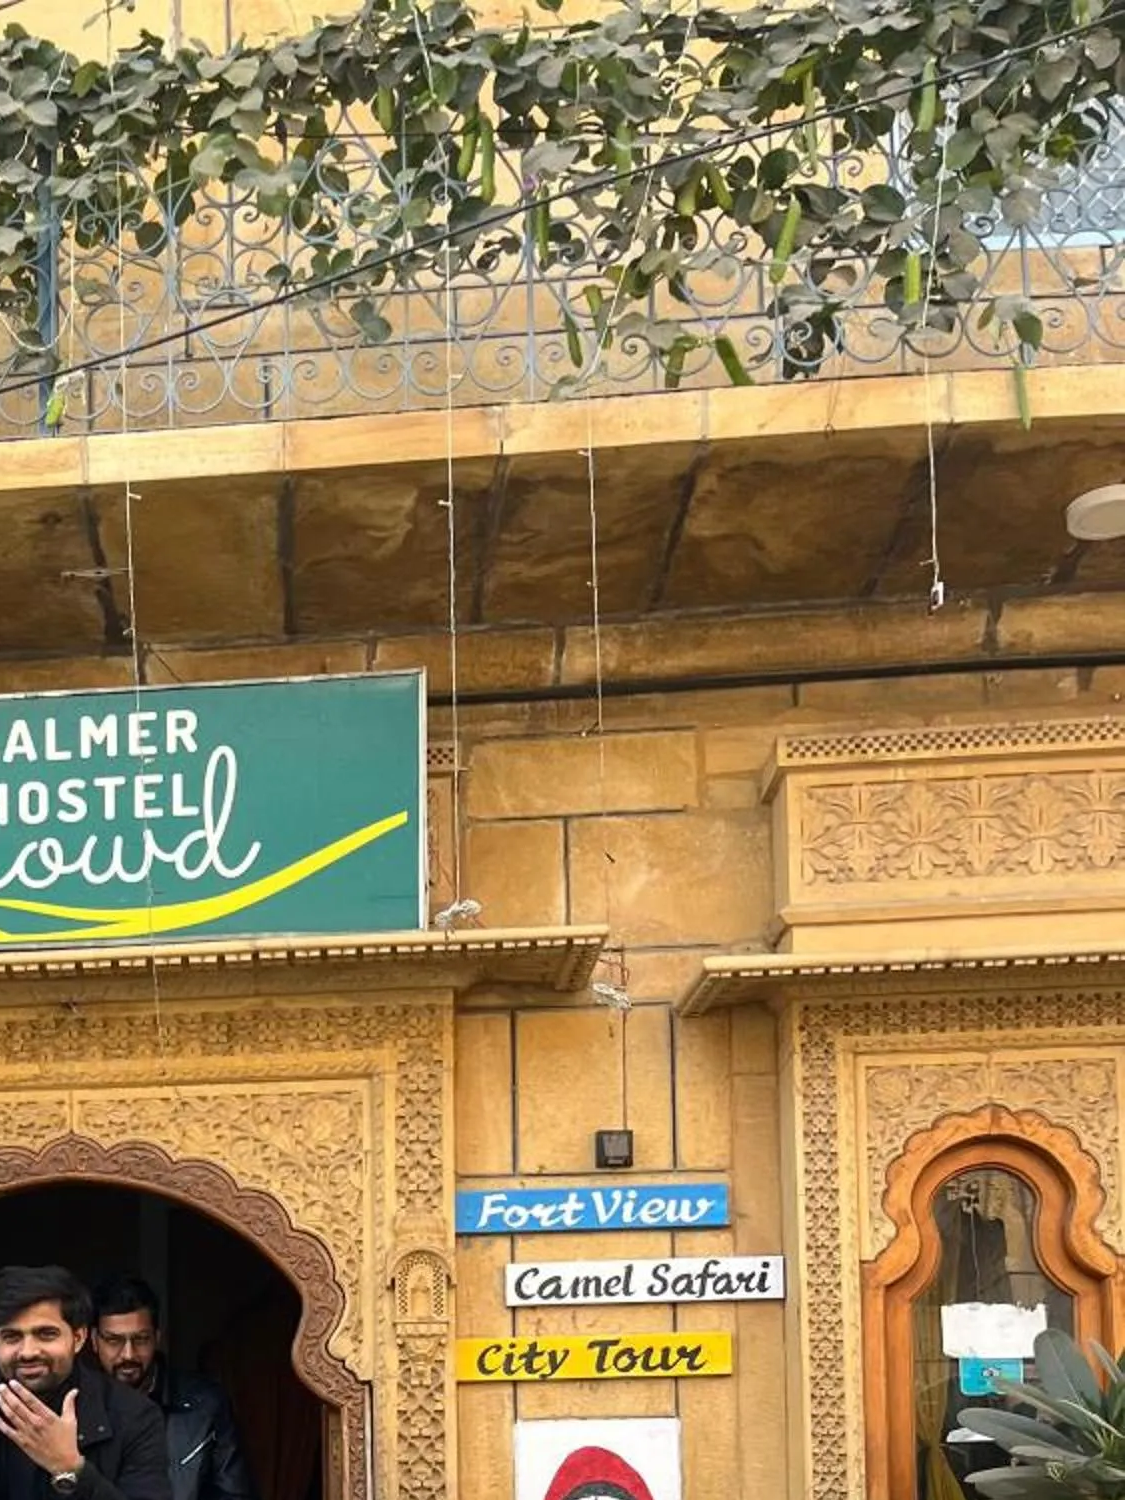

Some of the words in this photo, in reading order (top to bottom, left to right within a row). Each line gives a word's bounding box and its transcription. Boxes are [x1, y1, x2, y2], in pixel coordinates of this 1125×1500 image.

[475, 1191, 585, 1229] Fort
[590, 1189, 716, 1225] View
[513, 1263, 634, 1301] Camel
[646, 1259, 772, 1299] Safari
[475, 1341, 571, 1379] City
[587, 1339, 707, 1373] Tour
